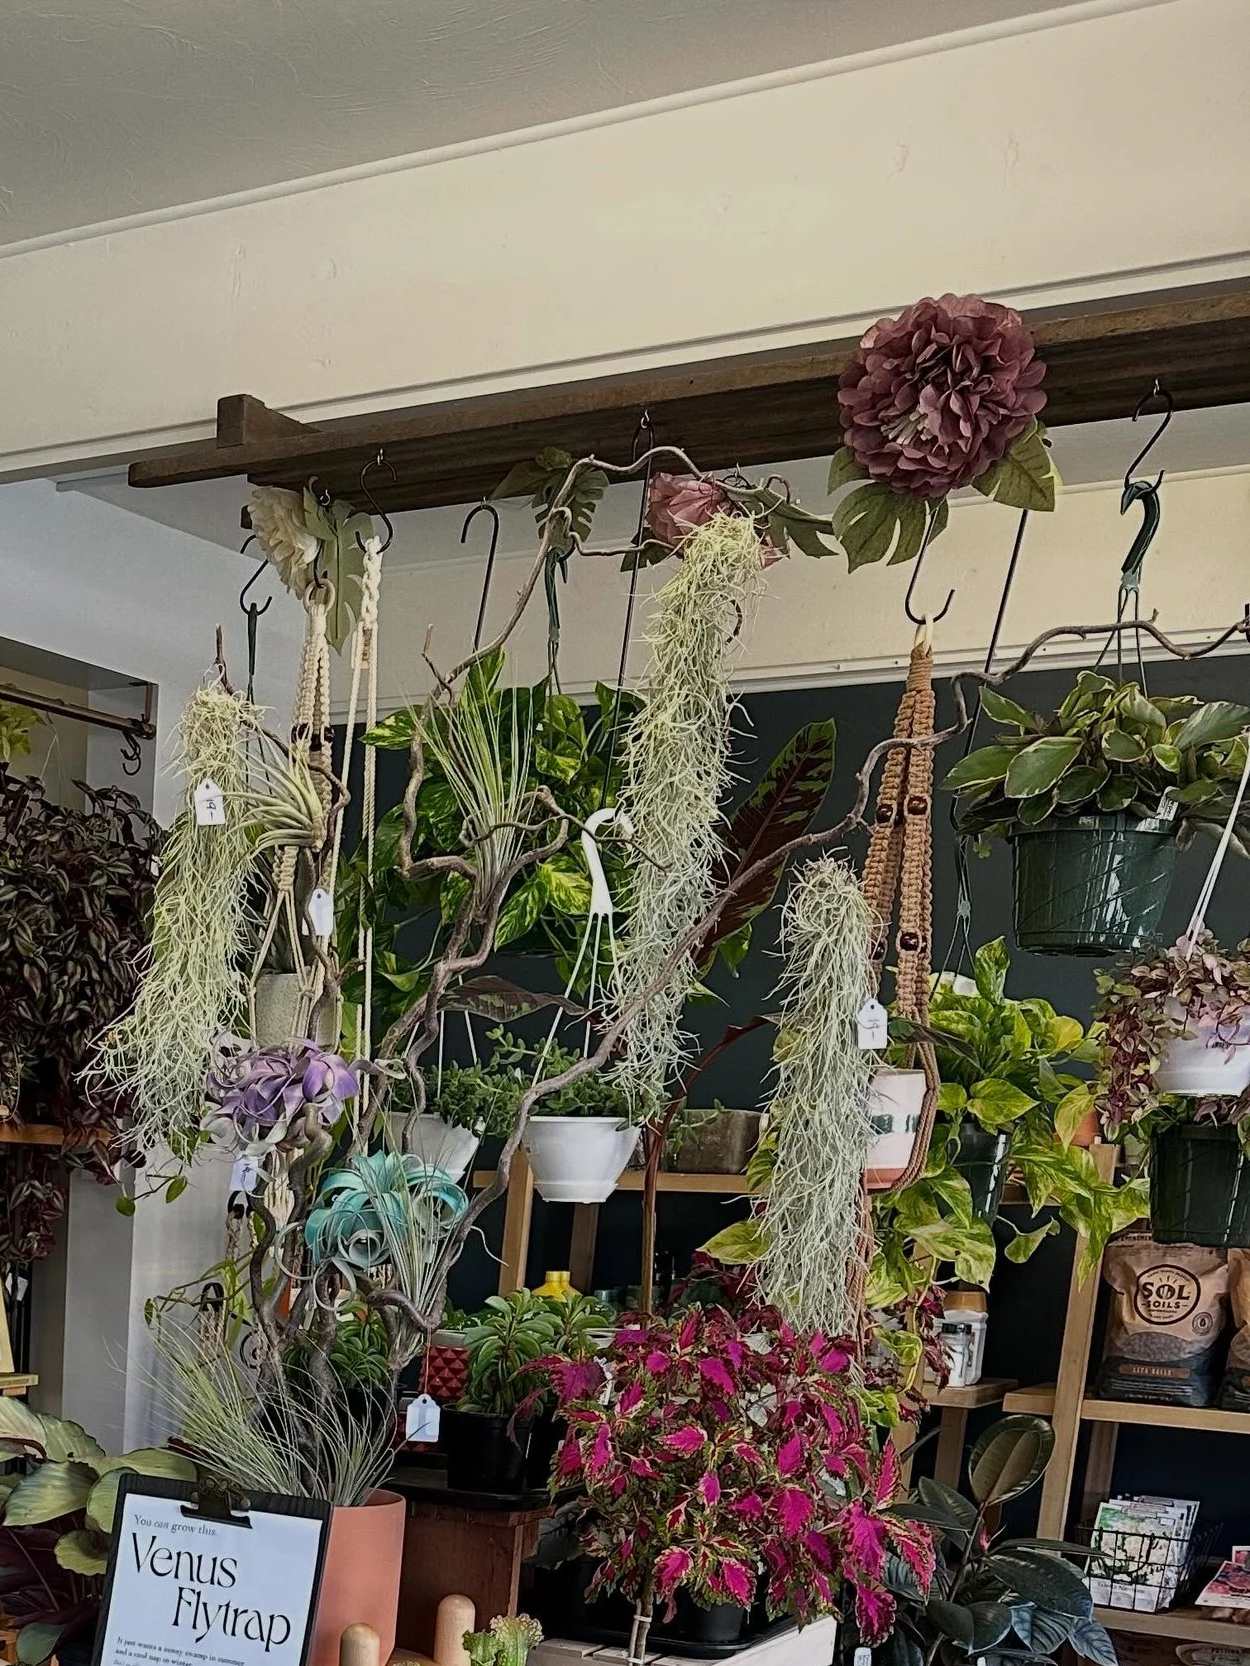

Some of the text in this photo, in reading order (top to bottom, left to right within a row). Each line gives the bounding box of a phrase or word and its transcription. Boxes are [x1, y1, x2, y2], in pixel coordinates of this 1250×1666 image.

[1141, 1281, 1191, 1300] SOL
[1146, 1300, 1181, 1309] SOILS
[134, 1514, 151, 1526] You
[154, 1521, 169, 1529] can
[171, 1523, 196, 1533] grow
[132, 1532, 237, 1588] Venus
[172, 1586, 291, 1652] Flytrap
